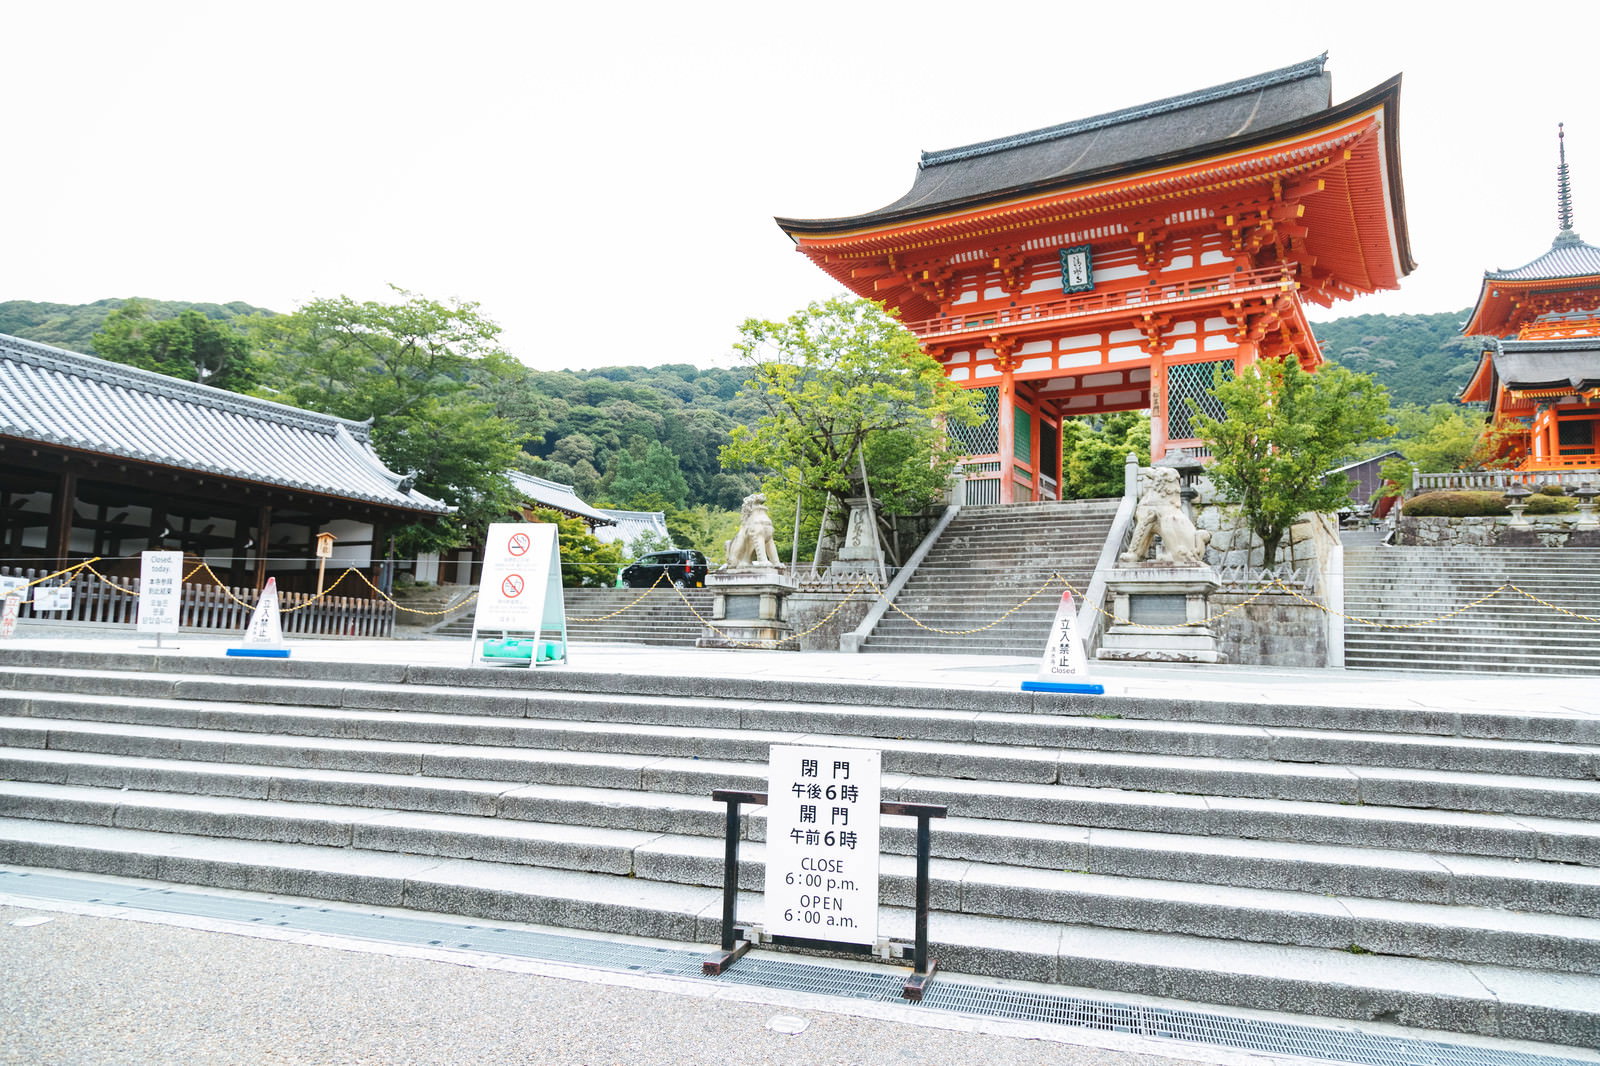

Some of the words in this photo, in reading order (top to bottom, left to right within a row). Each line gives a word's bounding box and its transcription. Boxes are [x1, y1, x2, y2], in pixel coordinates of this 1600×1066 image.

[259, 600, 271, 637] 立入禁止
[1060, 618, 1070, 667] 立入禁止
[1051, 666, 1076, 675] Closed
[792, 782, 858, 803] 午後6時
[790, 828, 857, 850] 午前6時
[801, 857, 844, 873] CLOSE
[827, 878, 859, 891] p.m.
[800, 894, 842, 911] OPEN
[826, 915, 858, 928] a.m.
